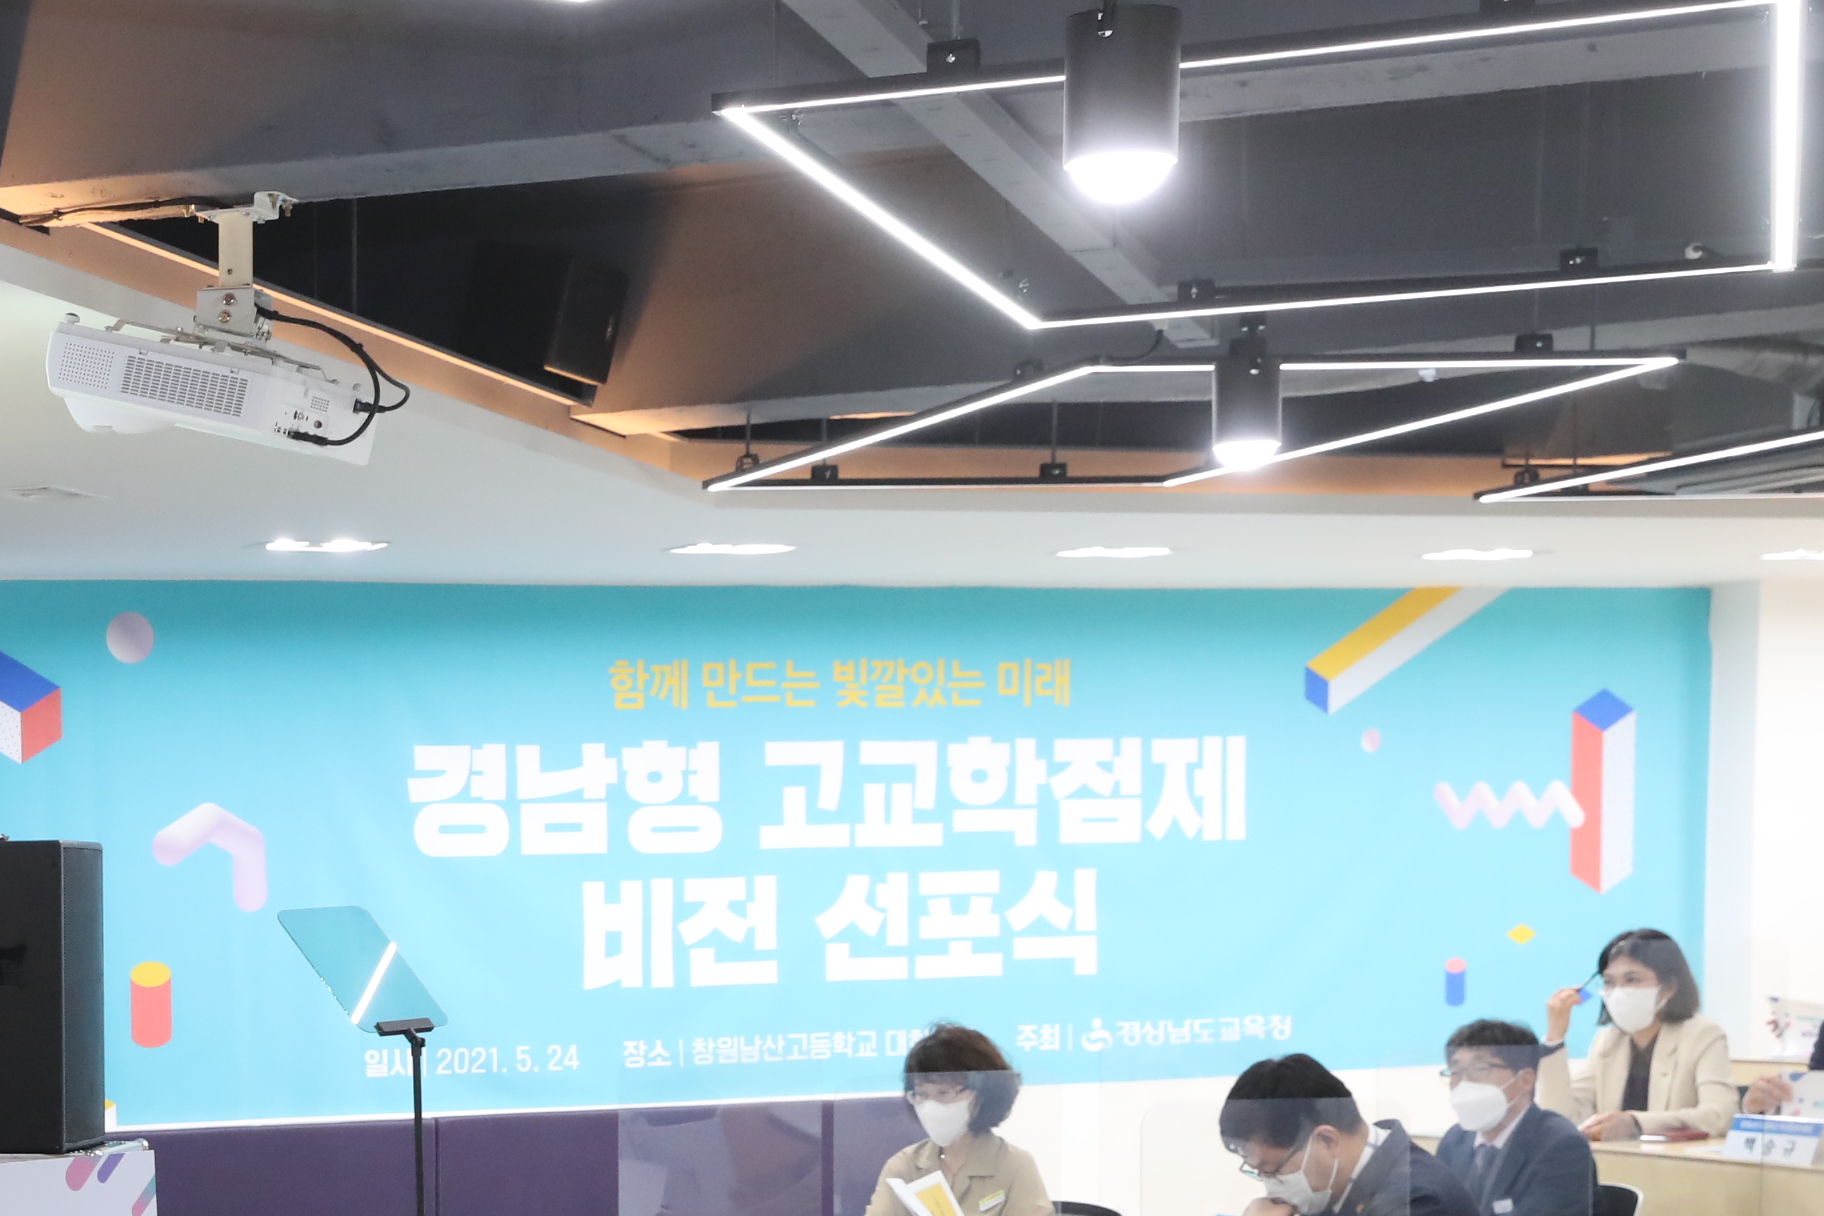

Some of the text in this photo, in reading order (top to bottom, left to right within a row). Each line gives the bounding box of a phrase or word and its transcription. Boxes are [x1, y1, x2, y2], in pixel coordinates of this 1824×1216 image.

[609, 657, 1072, 711] 함께 만드는 빛깔있는 미래
[407, 735, 1249, 858] 경남형 고교학점제
[582, 867, 1100, 992] 비전 선포식
[691, 1029, 879, 1066] 창원남산고등학교
[1015, 1023, 1061, 1052] 주최
[1115, 1014, 1293, 1047] 경상남도교육청
[436, 1047, 508, 1075] 2021.
[547, 1044, 580, 1071] 24
[622, 1039, 672, 1069] 장소
